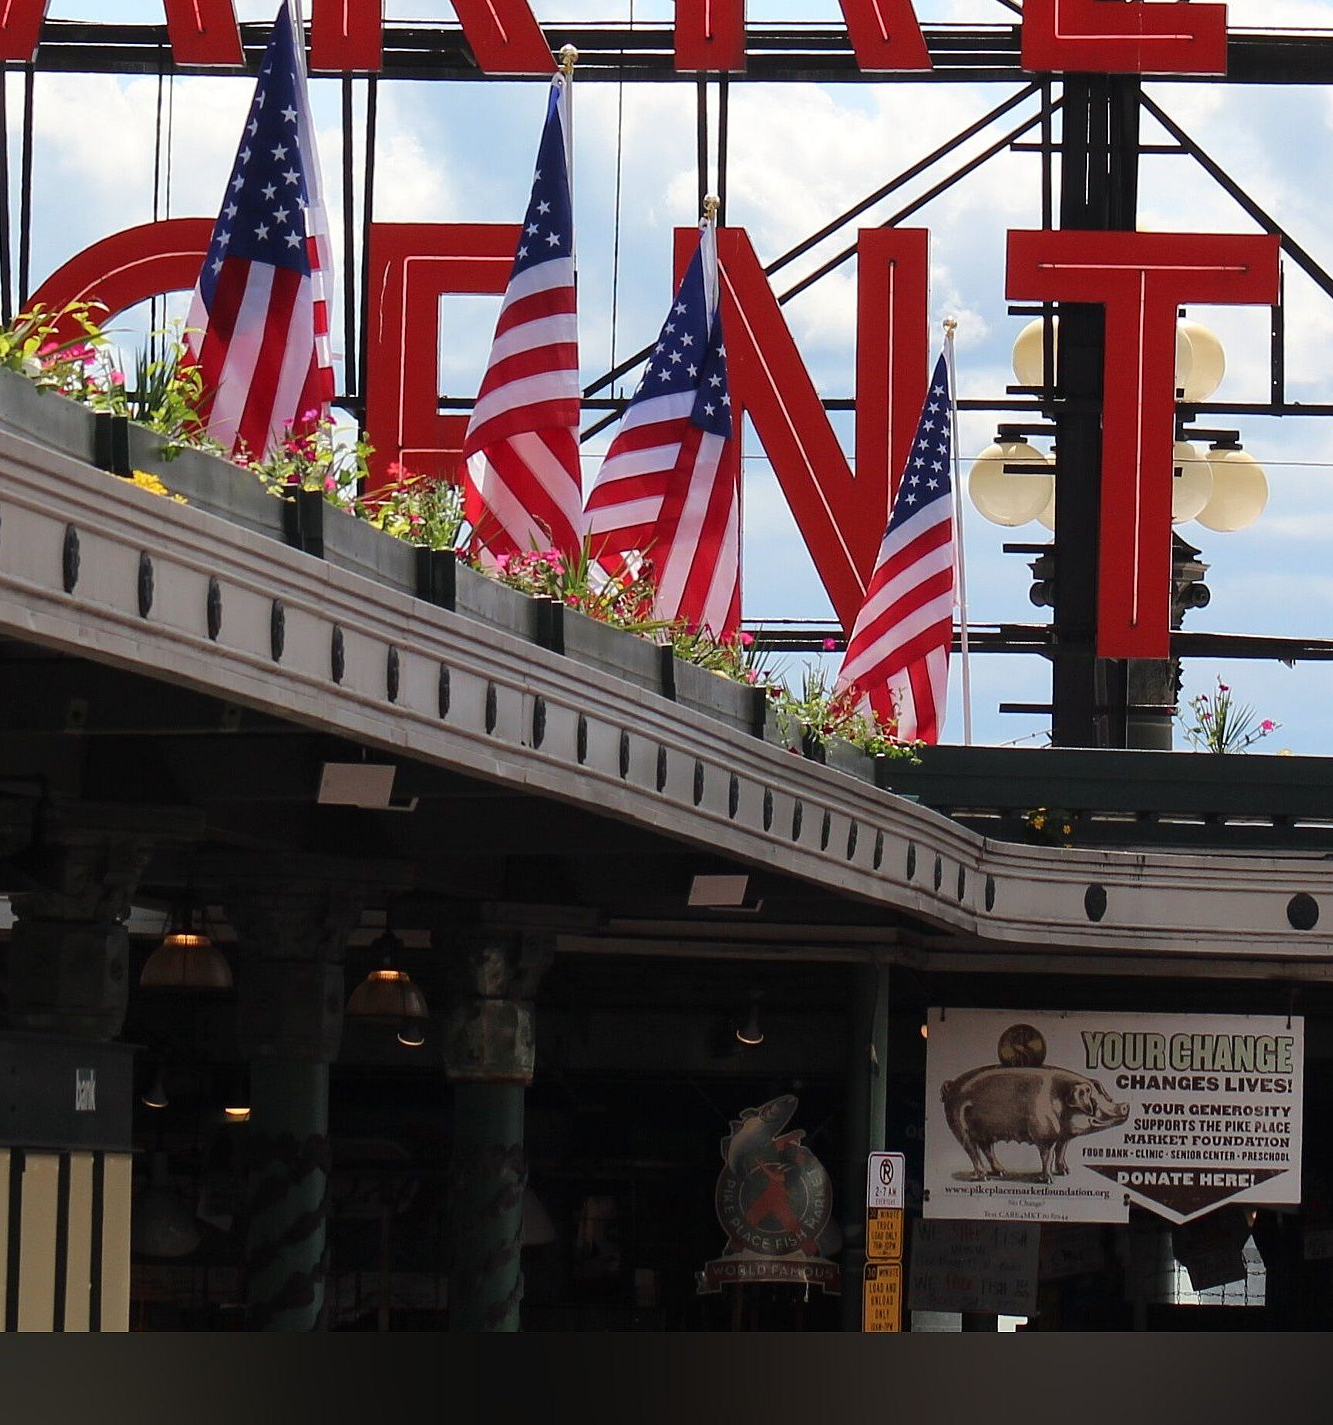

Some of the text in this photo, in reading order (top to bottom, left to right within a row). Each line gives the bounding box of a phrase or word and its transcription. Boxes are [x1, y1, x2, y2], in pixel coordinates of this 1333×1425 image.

[1081, 1031, 1294, 1073] YOUR CHANGE
[1116, 1074, 1293, 1093] CHANGES LIVES!
[1141, 1103, 1291, 1117] YOUR GENEROSITY
[1134, 1118, 1291, 1135] SUPPORTS THE PIKE PLACE
[1124, 1134, 1290, 1148] MARKET FOUNDATION
[1106, 1148, 1129, 1158] BANK
[1135, 1149, 1164, 1160] CLINIC
[1170, 1150, 1201, 1161] SENIOR
[1202, 1150, 1235, 1161] CENTER
[1242, 1151, 1291, 1162] PRESCHOOL
[1116, 1171, 1256, 1187] DONATE HERE!
[944, 1185, 1110, 1199] www.pikeplacemarketfoundation.org
[722, 1180, 736, 1215] PIKE
[729, 1218, 770, 1250] PLACE
[775, 1230, 807, 1249] FISH
[711, 1263, 834, 1279] WORLD FAMOUS
